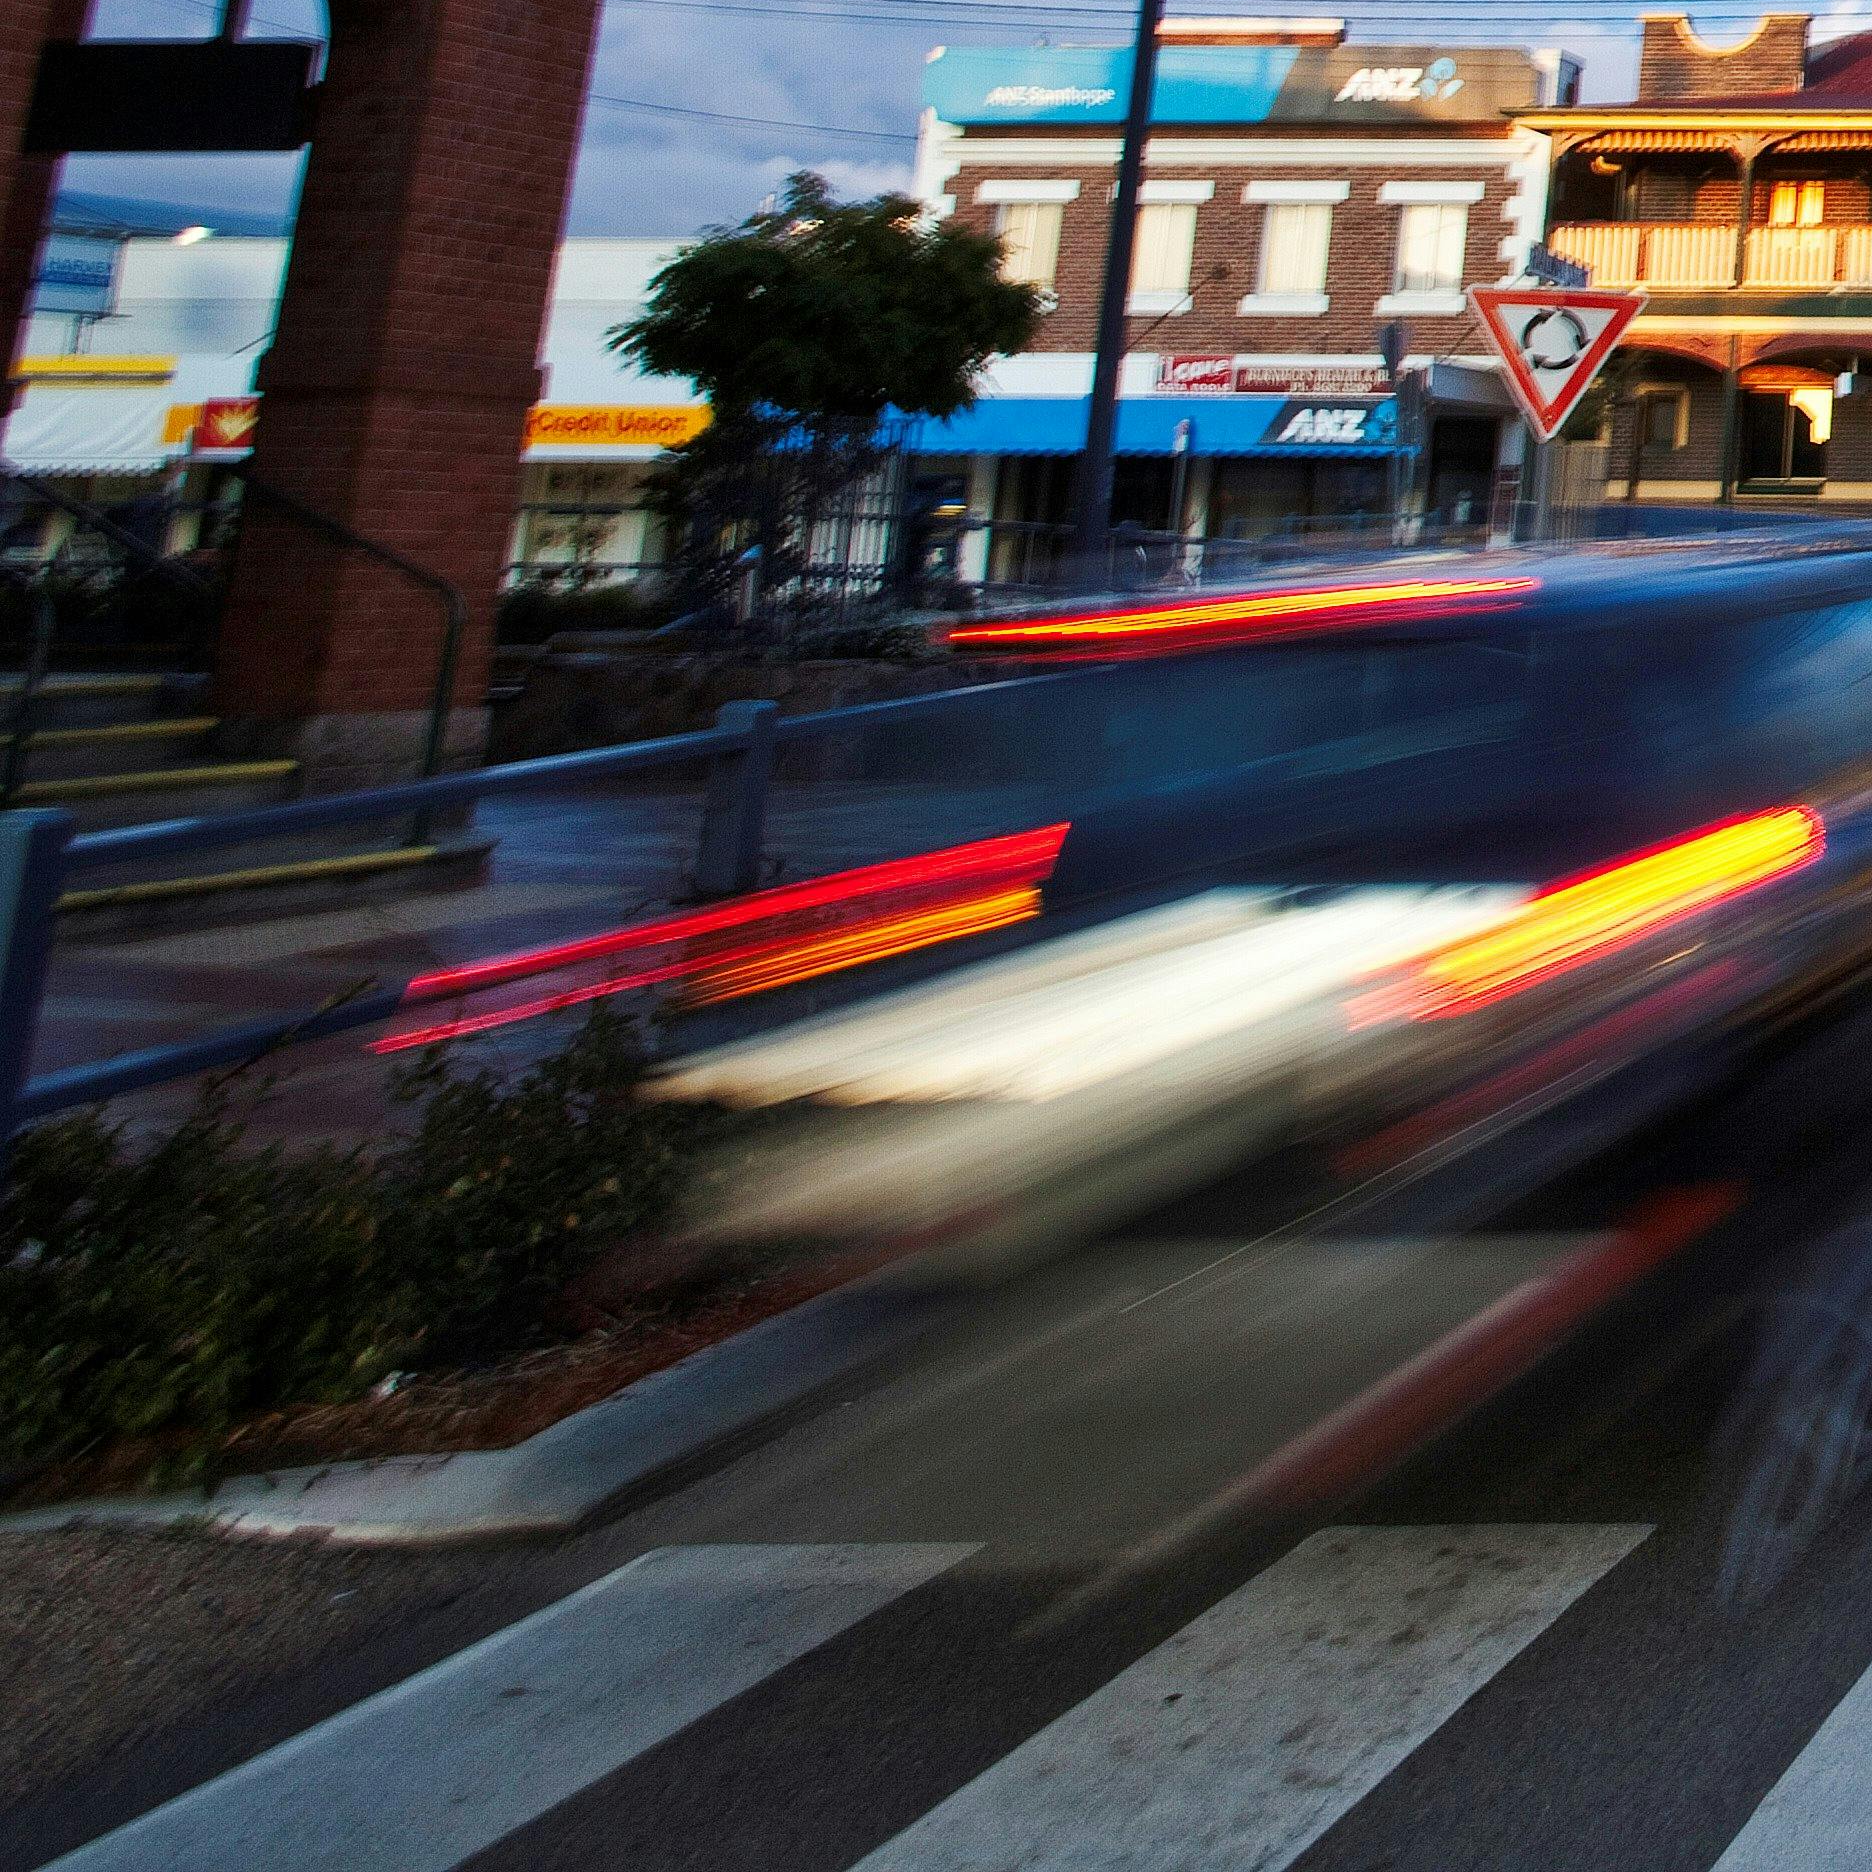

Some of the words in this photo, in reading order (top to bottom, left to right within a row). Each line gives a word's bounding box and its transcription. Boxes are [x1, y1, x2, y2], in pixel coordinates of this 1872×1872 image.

[1333, 67, 1424, 102] ANZ
[537, 411, 609, 436] Credit
[617, 411, 688, 436] Union
[1277, 409, 1367, 443] ANZ
